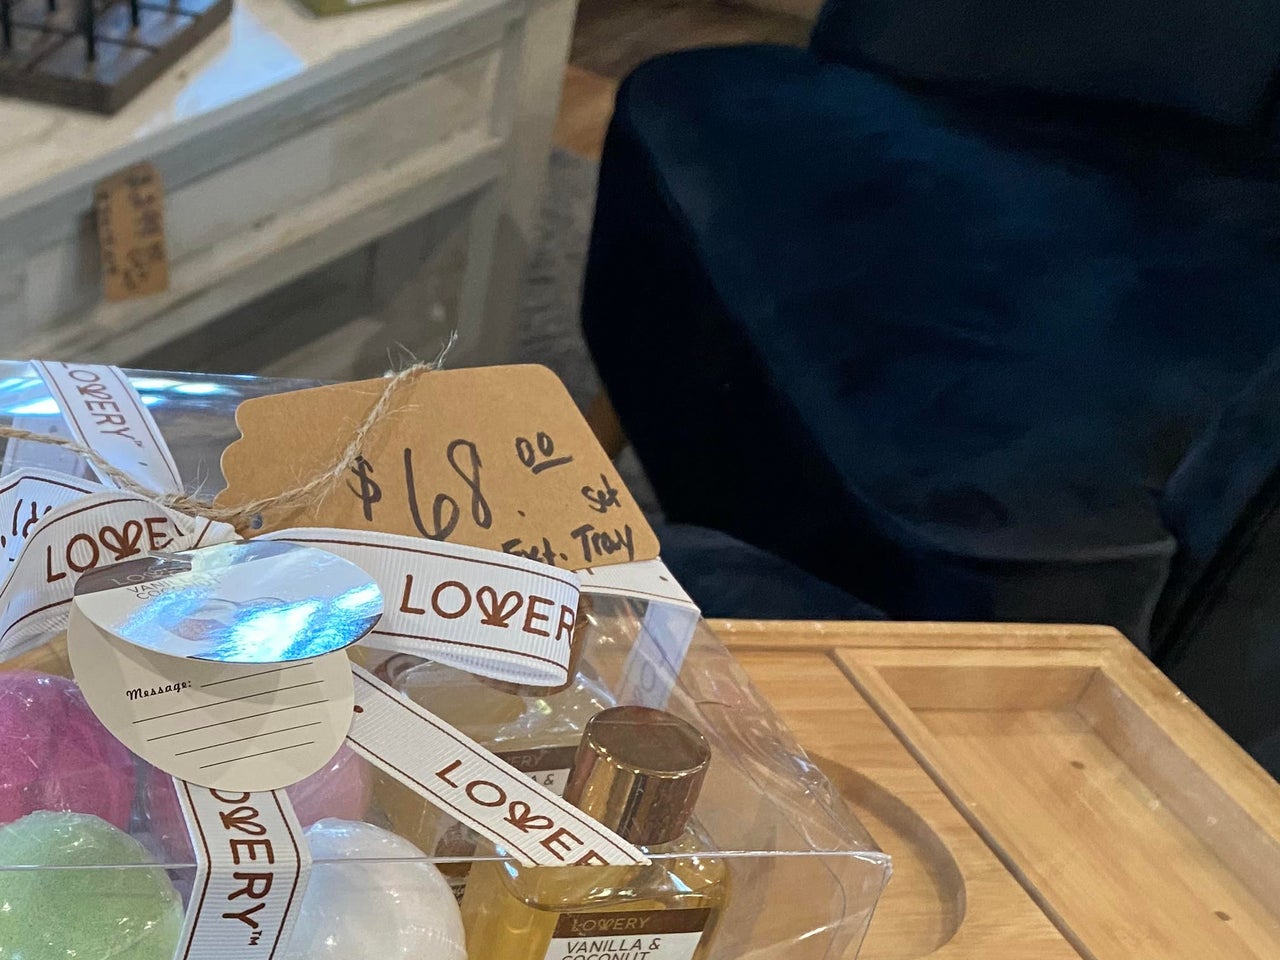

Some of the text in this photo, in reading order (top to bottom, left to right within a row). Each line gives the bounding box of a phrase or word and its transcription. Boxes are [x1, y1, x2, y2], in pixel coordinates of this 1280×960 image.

[47, 517, 176, 583] LOVE
[570, 523, 634, 563] Tray
[400, 574, 575, 641] LOVER
[126, 680, 192, 701] Message:
[435, 759, 611, 866] LOVE
[571, 916, 651, 932] LOVERY
[567, 937, 662, 954] VANILLA &
